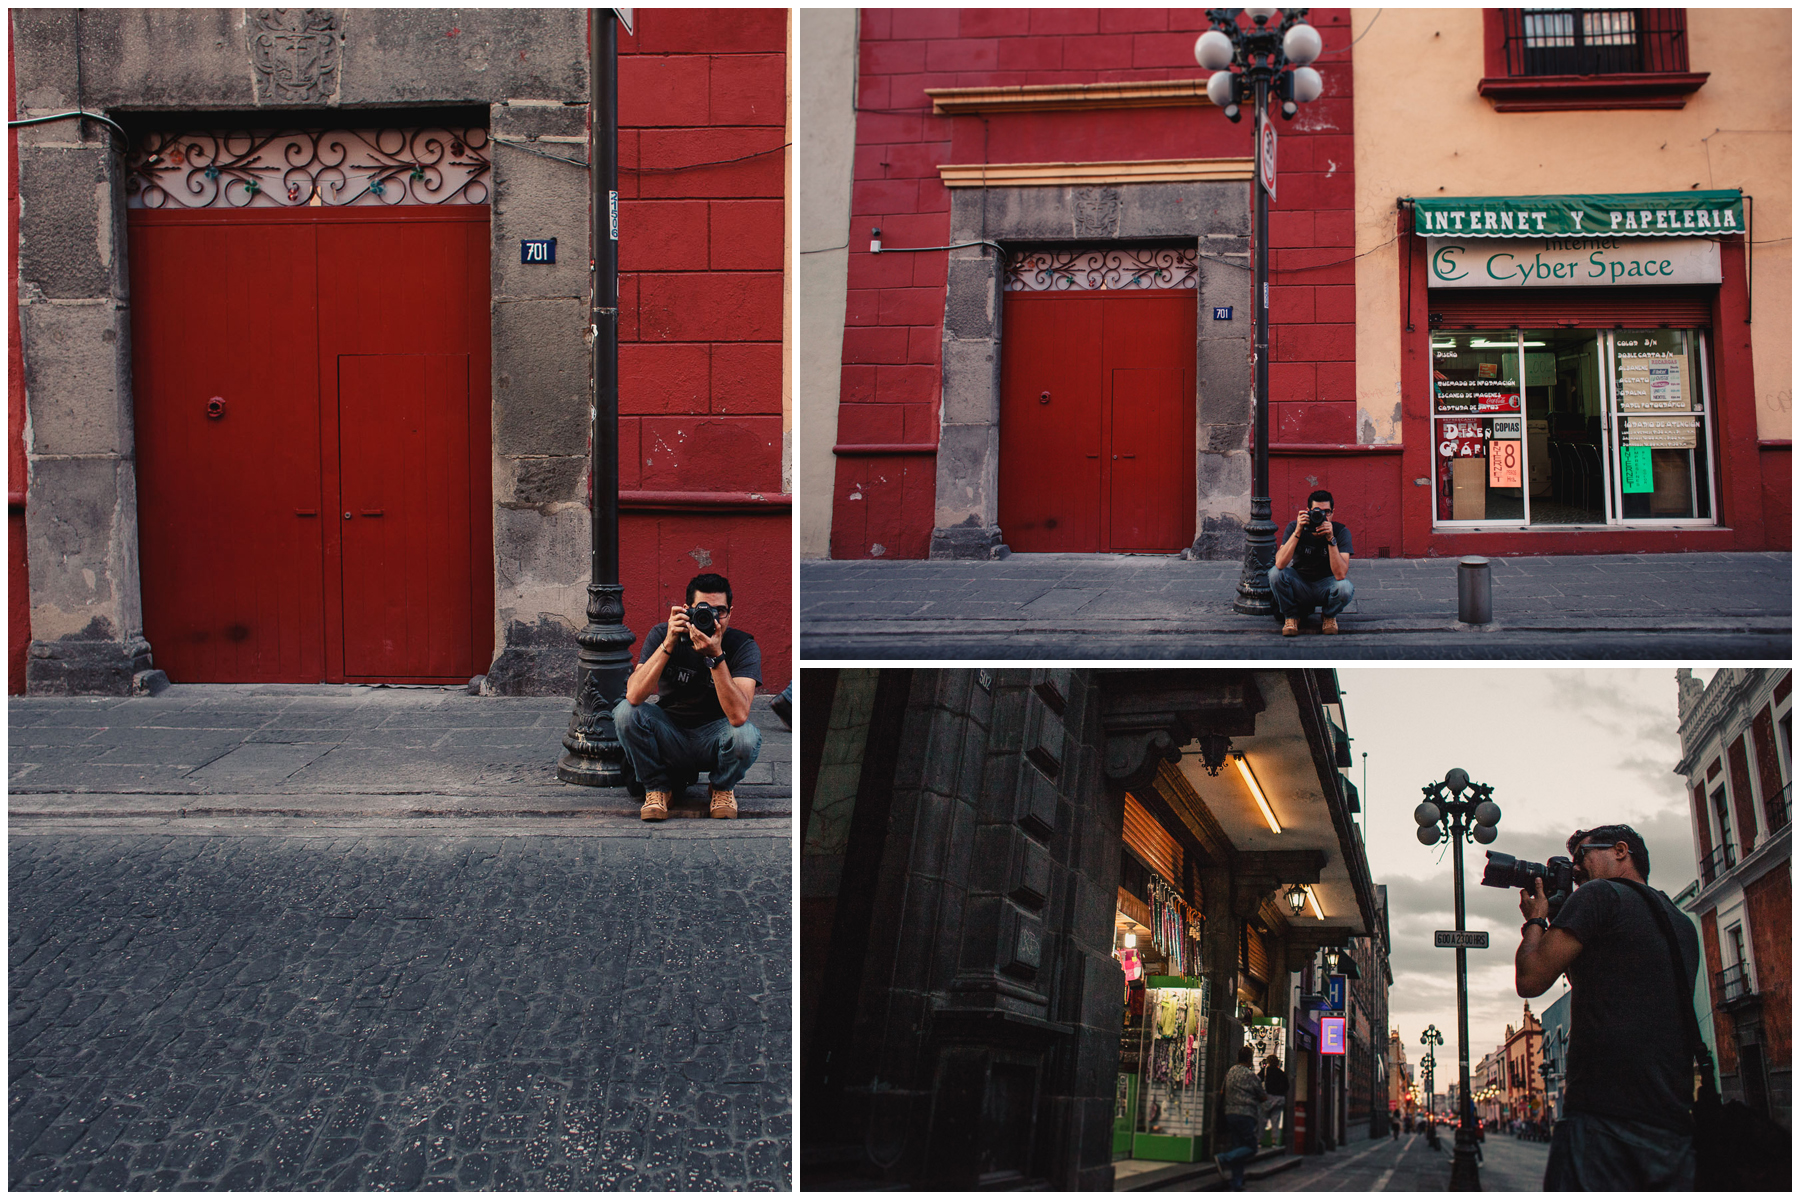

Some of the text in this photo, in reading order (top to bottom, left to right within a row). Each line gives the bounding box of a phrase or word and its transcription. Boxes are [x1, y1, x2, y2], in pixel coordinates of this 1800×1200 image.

[610, 191, 618, 238] 21506
[1425, 209, 1737, 231] INTERNET Y PAPELERIA
[526, 243, 547, 260] 701
[1545, 237, 1620, 251] Internet
[1486, 250, 1675, 286] Cyber Space
[1216, 308, 1229, 319] 701
[1494, 422, 1520, 432] COPIAS
[1504, 444, 1516, 469] 8
[677, 671, 690, 683] Ni
[1451, 934, 1456, 944] A
[1473, 935, 1486, 945] HRS
[1329, 983, 1339, 1003] H
[1327, 1025, 1338, 1046] E
